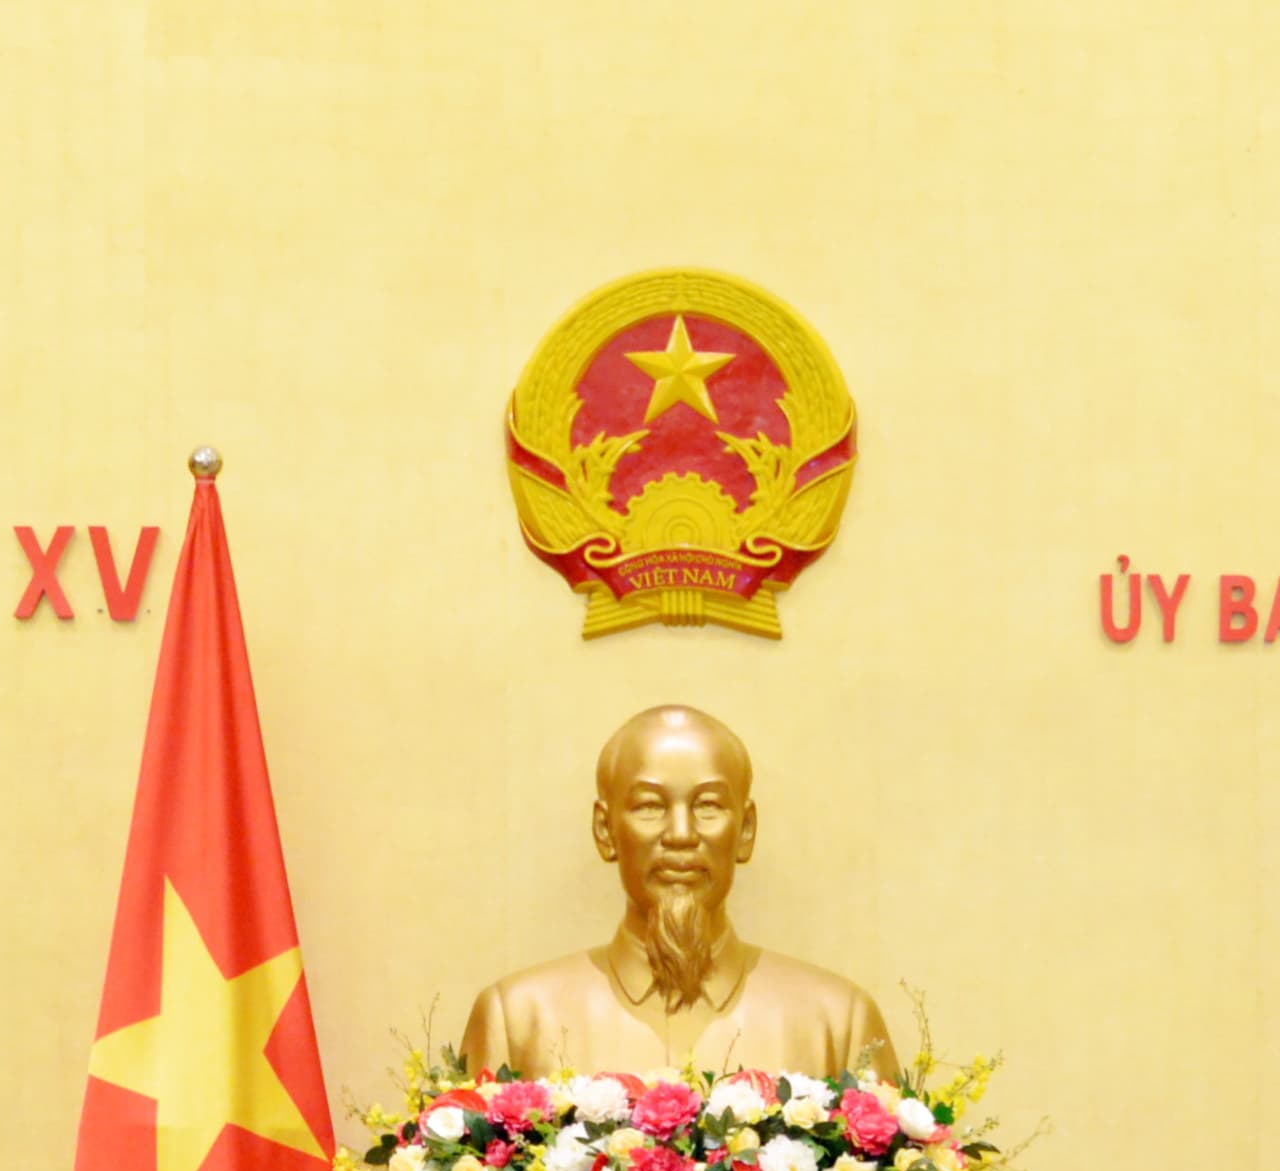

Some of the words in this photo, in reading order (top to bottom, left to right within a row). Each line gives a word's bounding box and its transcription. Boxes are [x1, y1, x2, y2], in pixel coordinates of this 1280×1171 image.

[14, 525, 161, 623] XV
[683, 568, 737, 589] NAM
[1099, 553, 1191, 643] ỦY
